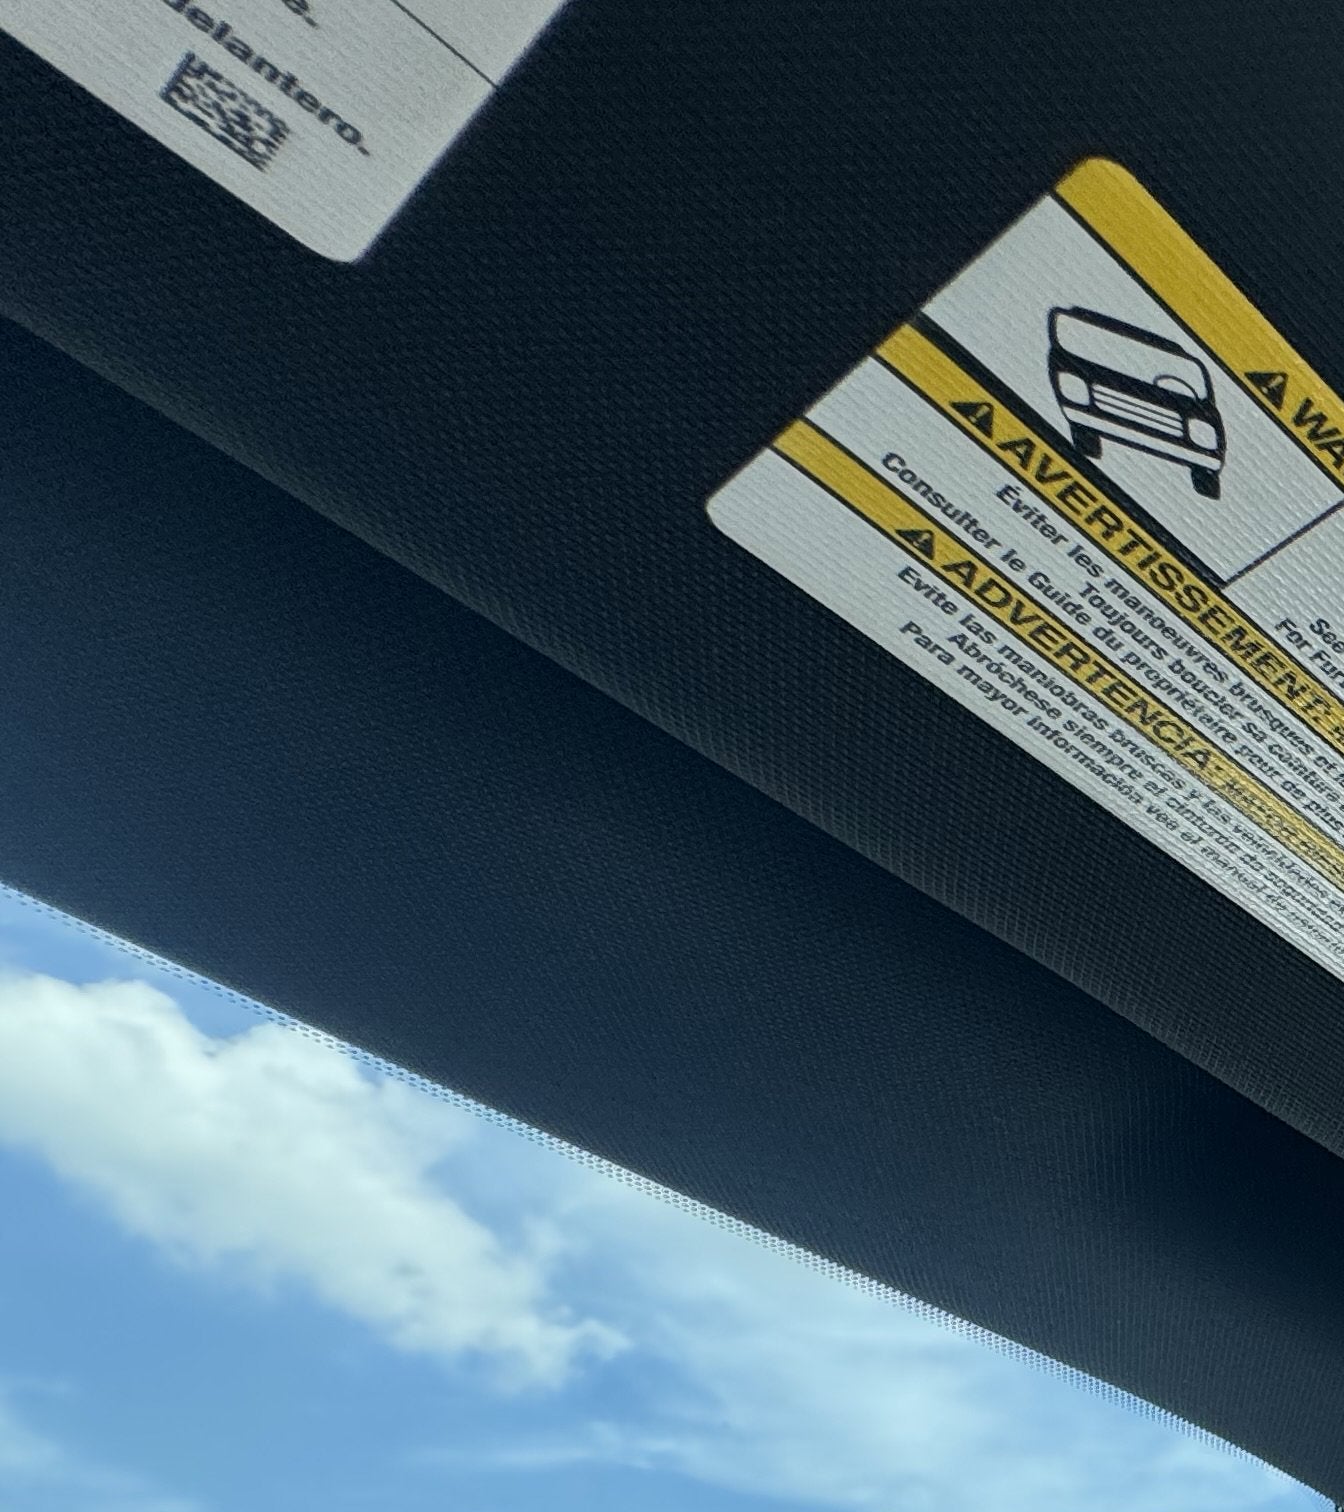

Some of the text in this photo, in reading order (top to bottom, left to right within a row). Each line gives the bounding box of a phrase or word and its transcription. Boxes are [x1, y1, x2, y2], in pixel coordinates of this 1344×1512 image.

[163, 0, 371, 156] elantero.
[877, 449, 1006, 554] Consulter
[998, 548, 1031, 574] le
[1024, 569, 1097, 628] Guide
[1090, 623, 1128, 653] du
[1118, 648, 1242, 747] propriétaire
[1232, 743, 1284, 783] pour
[1277, 777, 1311, 801] de
[939, 551, 1230, 779] ADVERTENCIA:
[993, 480, 1075, 548] Éviter
[1064, 543, 1109, 579] les
[1102, 576, 1232, 685] manoeuvres
[1224, 681, 1318, 757] brusques
[1311, 752, 1340, 774] et
[994, 427, 1338, 724] AVERTISSEMENT:
[1071, 580, 1174, 663] Toujours
[1165, 658, 1247, 723] boucler
[1239, 720, 1270, 744] sa
[1264, 740, 1344, 805] ceinture
[1272, 616, 1317, 653] For
[895, 565, 963, 617] Evite
[958, 613, 1000, 645] las
[995, 642, 1113, 731] maniobras
[1106, 728, 1190, 790] bruscas
[1181, 789, 1204, 804] y
[1199, 798, 1235, 824] las
[897, 620, 959, 666] Para
[952, 664, 1028, 720] mayor
[1025, 714, 1149, 805] información
[1142, 804, 1181, 831] vea
[1178, 828, 1203, 846] el
[944, 629, 1067, 721] Abróchese
[1058, 717, 1147, 783] siempre
[1142, 779, 1167, 797] el
[1162, 794, 1244, 854] cinturón
[1238, 851, 1268, 872] de
